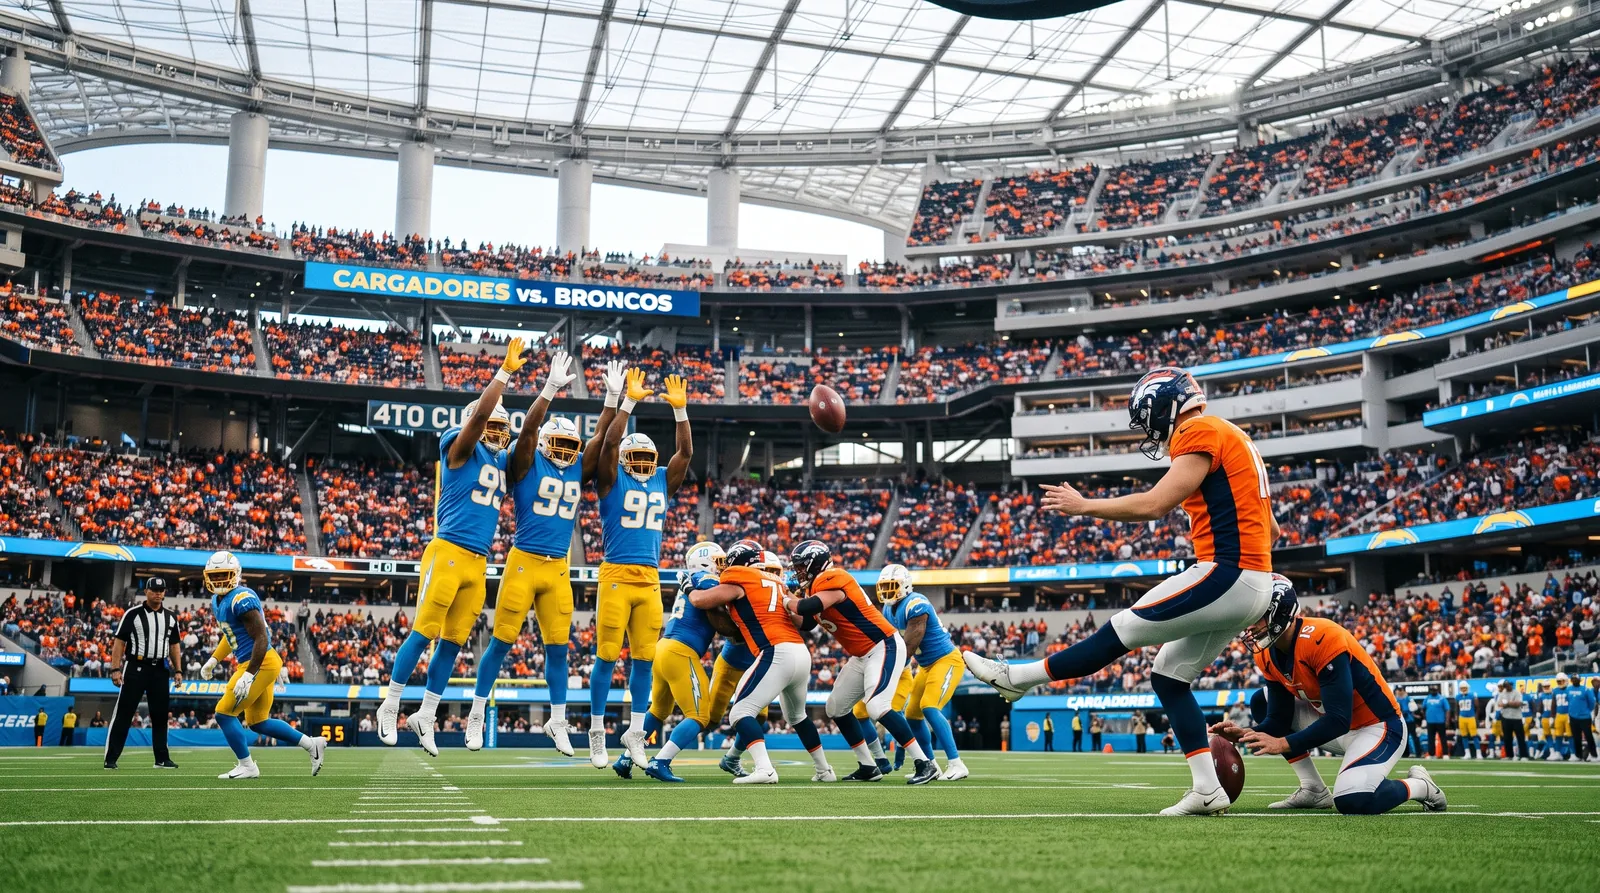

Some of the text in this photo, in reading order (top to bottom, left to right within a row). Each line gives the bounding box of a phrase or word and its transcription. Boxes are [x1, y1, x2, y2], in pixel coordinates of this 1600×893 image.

[333, 269, 673, 312] CARGADORES vs. BRONCOS
[373, 403, 425, 427] 4TO
[1245, 440, 1271, 499] 1
[532, 475, 582, 520] 99
[620, 489, 666, 531] 92
[698, 548, 709, 558] 10
[760, 578, 787, 612] 7
